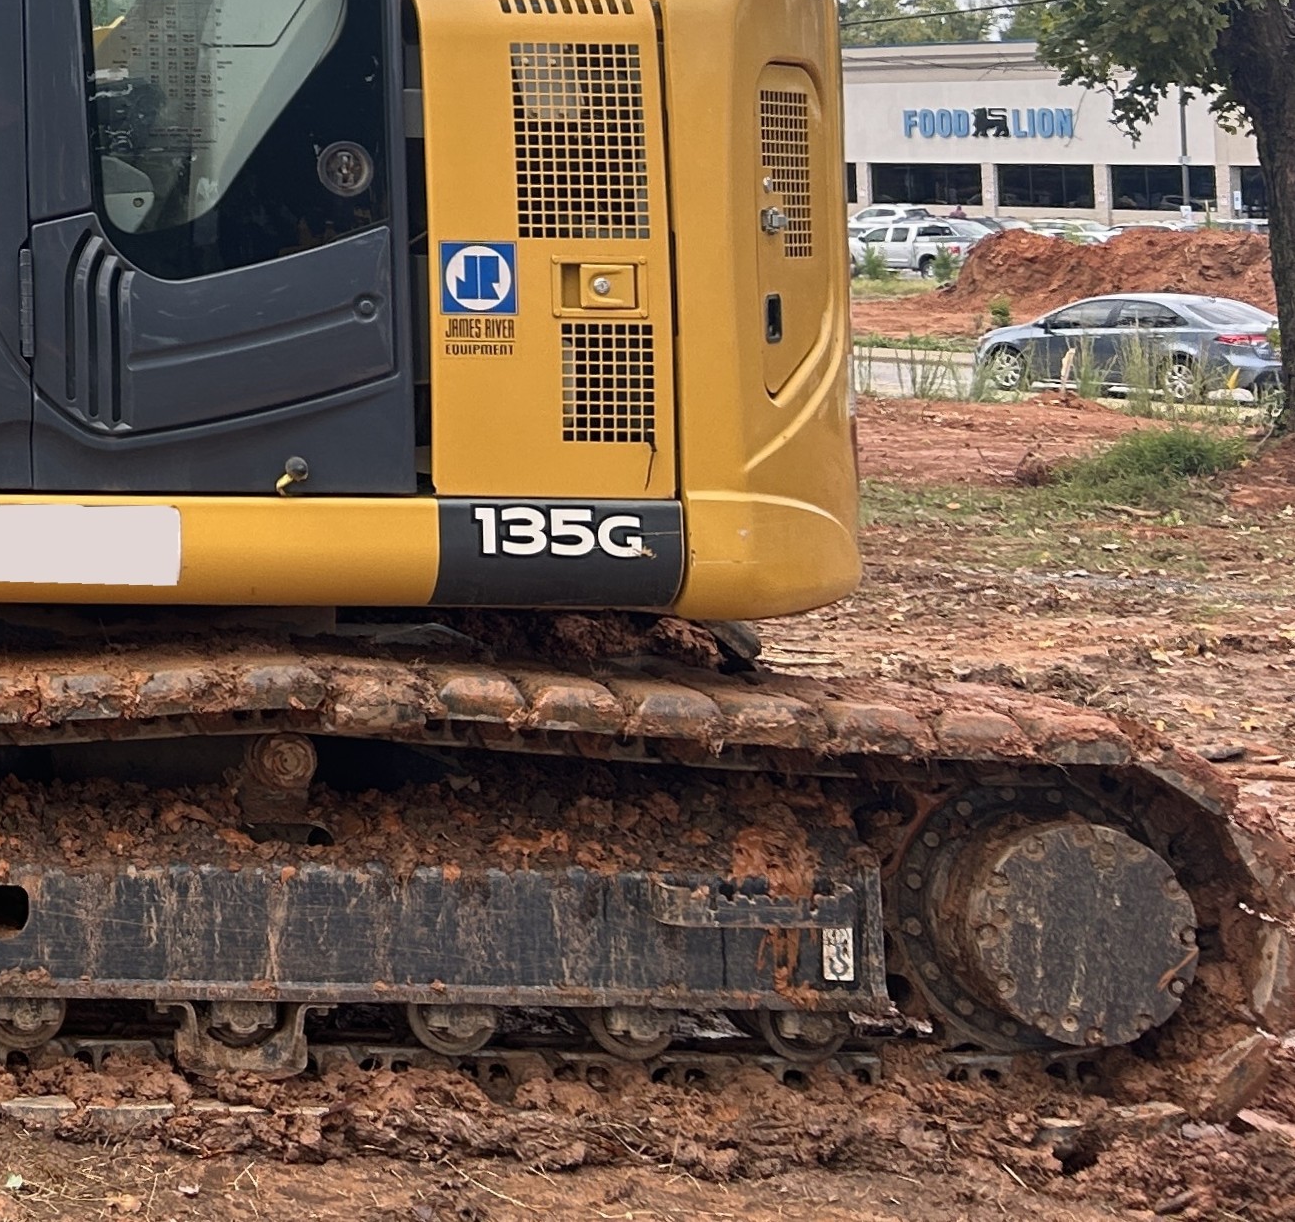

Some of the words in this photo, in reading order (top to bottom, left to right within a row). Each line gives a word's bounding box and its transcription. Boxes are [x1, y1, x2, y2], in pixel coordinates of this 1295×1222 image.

[903, 109, 969, 139] FOOD
[1012, 108, 1074, 139] LION
[455, 255, 500, 300] JR
[445, 318, 482, 339] JAMES
[485, 319, 515, 339] RIVER
[445, 344, 514, 356] EQUIPMENT
[474, 506, 643, 558] 135G
